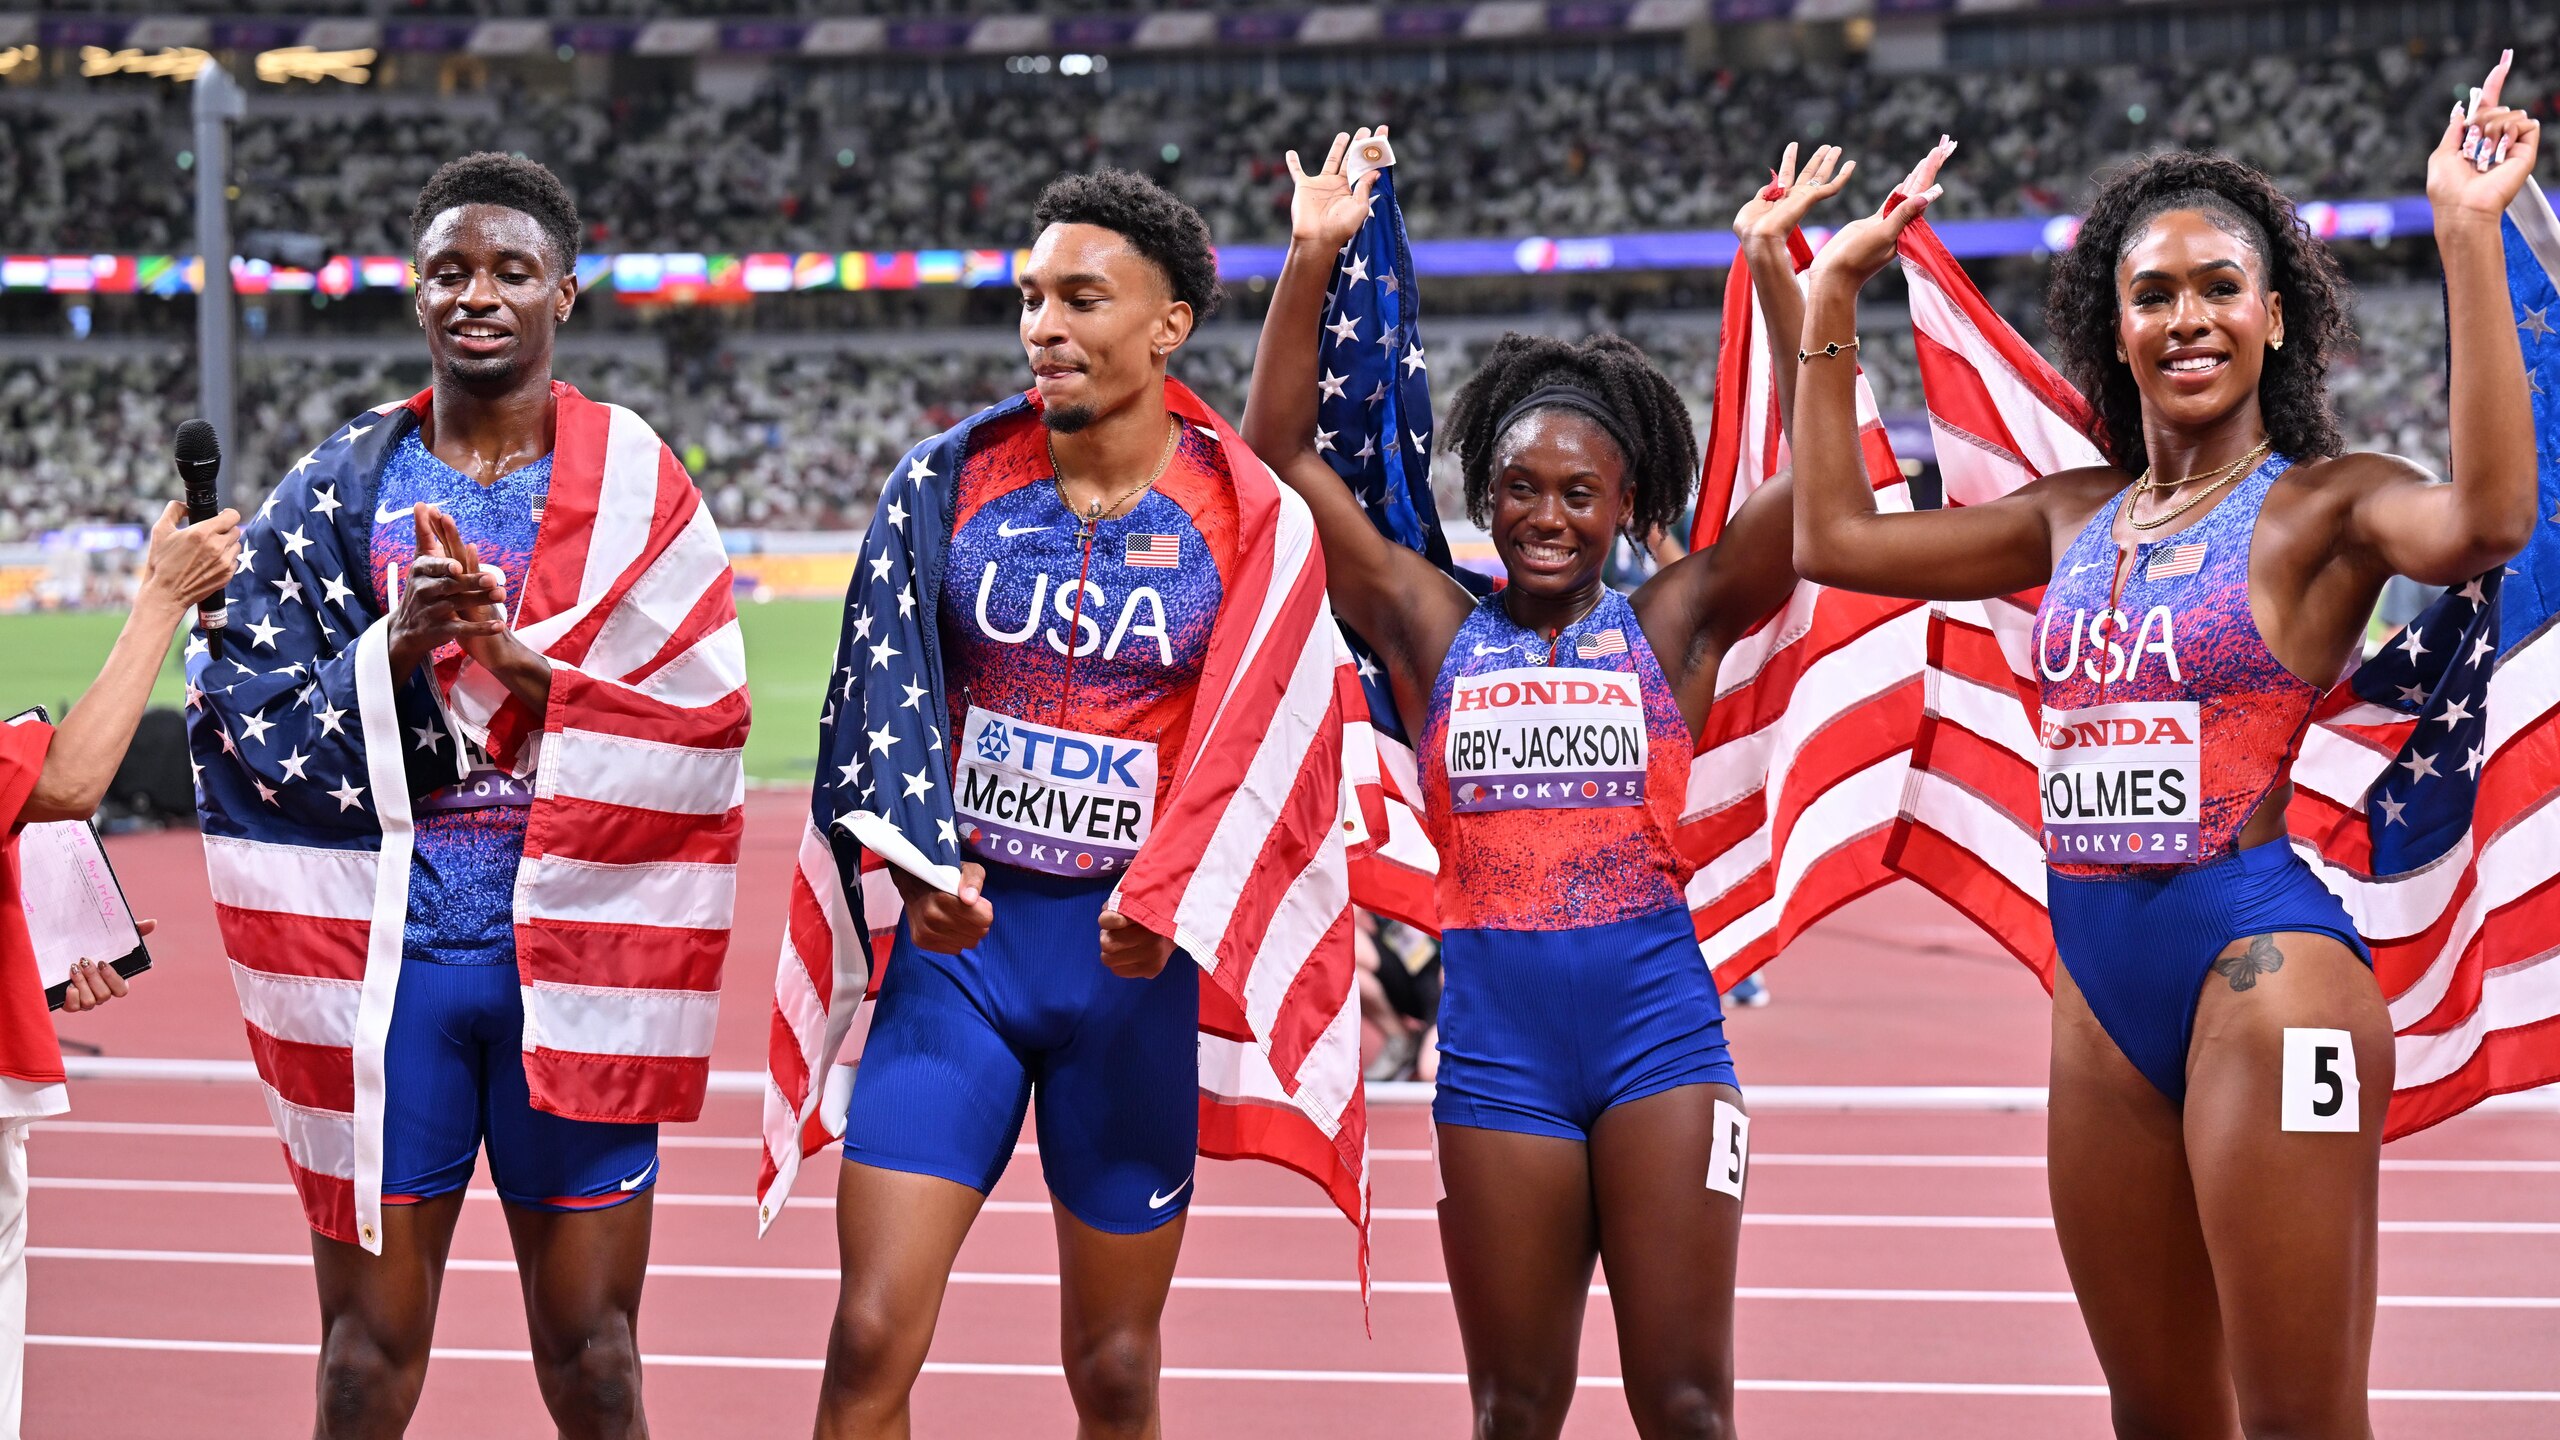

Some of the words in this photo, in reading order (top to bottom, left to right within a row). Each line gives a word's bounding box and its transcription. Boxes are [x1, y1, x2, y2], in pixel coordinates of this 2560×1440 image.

[975, 561, 1173, 666] USA
[2040, 605, 2181, 684] USA
[1454, 681, 1637, 712] HONDA
[1013, 726, 1143, 789] TDK
[1452, 725, 1639, 772] IRBY-JACKSON
[2040, 717, 2194, 751] HONDA
[963, 767, 1142, 843] McKIVER
[2041, 769, 2187, 819] HOLMES
[2312, 1046, 2343, 1117] 5
[1728, 1121, 1741, 1185] 5
